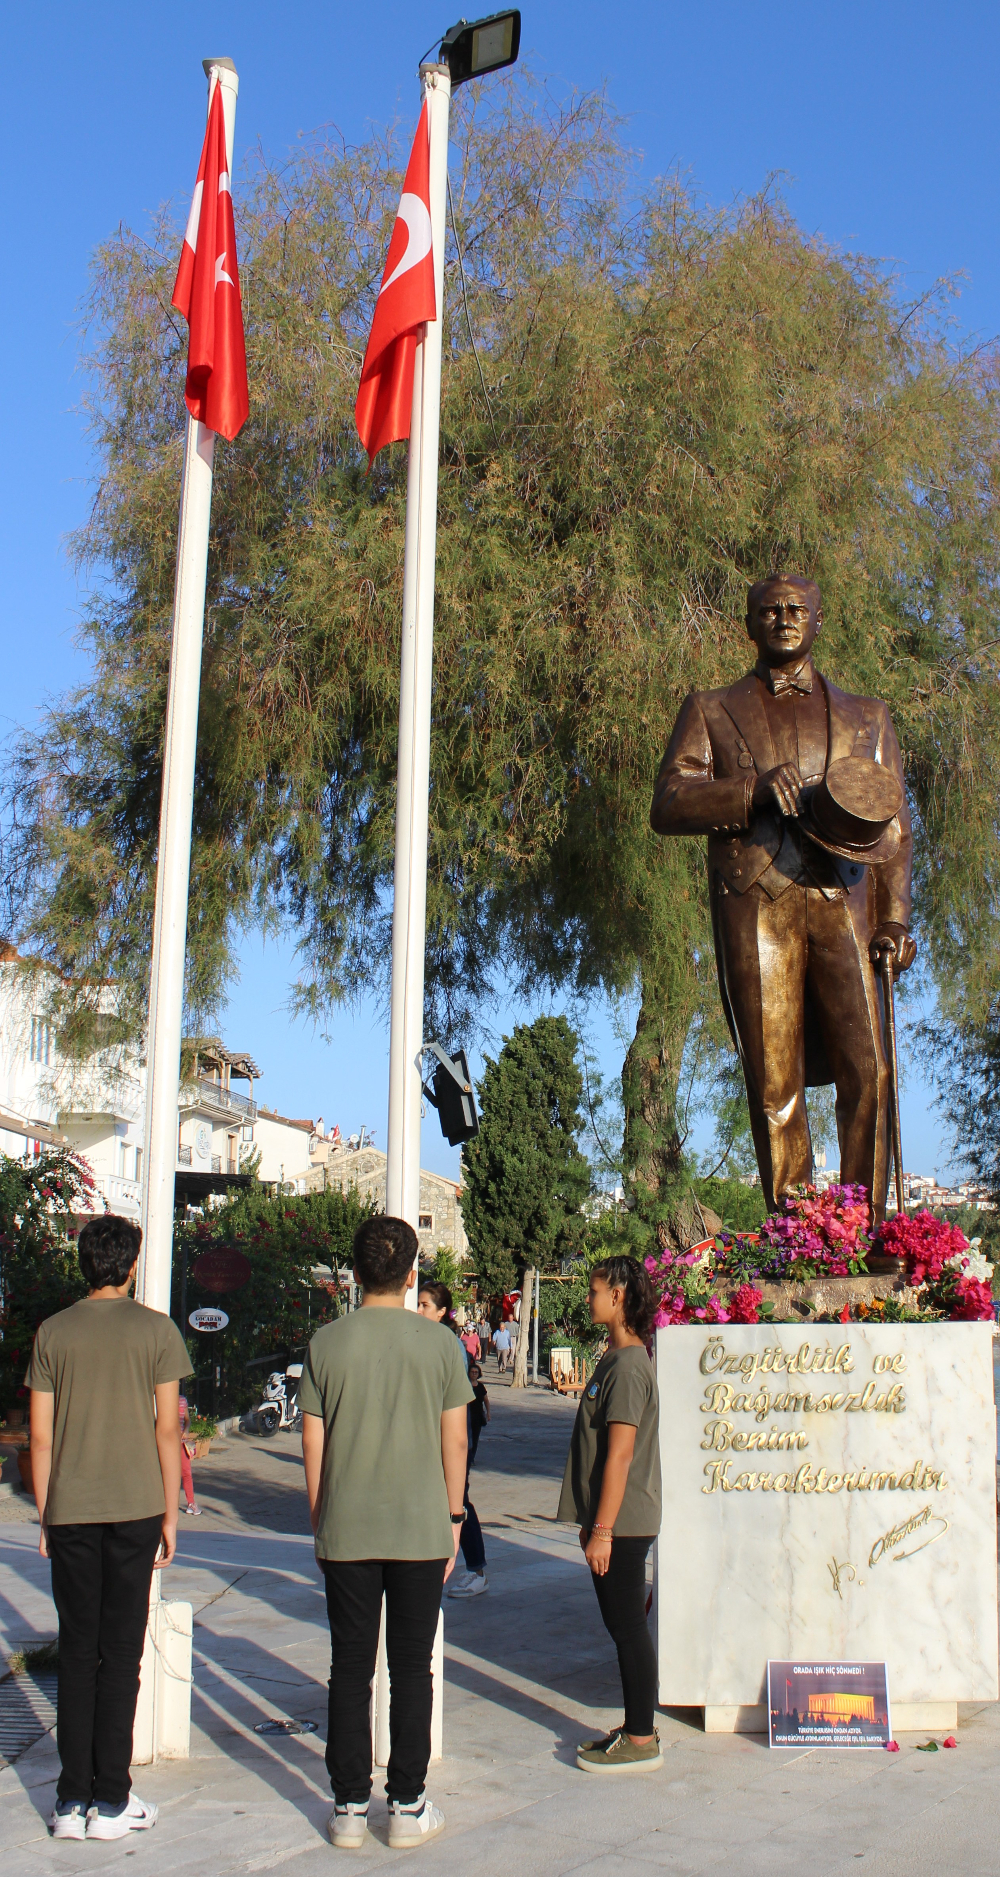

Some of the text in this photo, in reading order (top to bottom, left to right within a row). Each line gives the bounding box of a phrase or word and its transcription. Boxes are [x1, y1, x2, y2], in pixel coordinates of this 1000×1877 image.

[699, 1336, 907, 1384] Özgürlük ve
[699, 1380, 907, 1423] Bağımsızlık
[700, 1419, 809, 1452] Benim
[700, 1459, 949, 1494] Karakterimdir
[793, 1666, 813, 1675] ORADA
[813, 1666, 825, 1676] IŞIK
[825, 1665, 836, 1676] HİÇ
[836, 1665, 862, 1675] SÖNMEDİ
